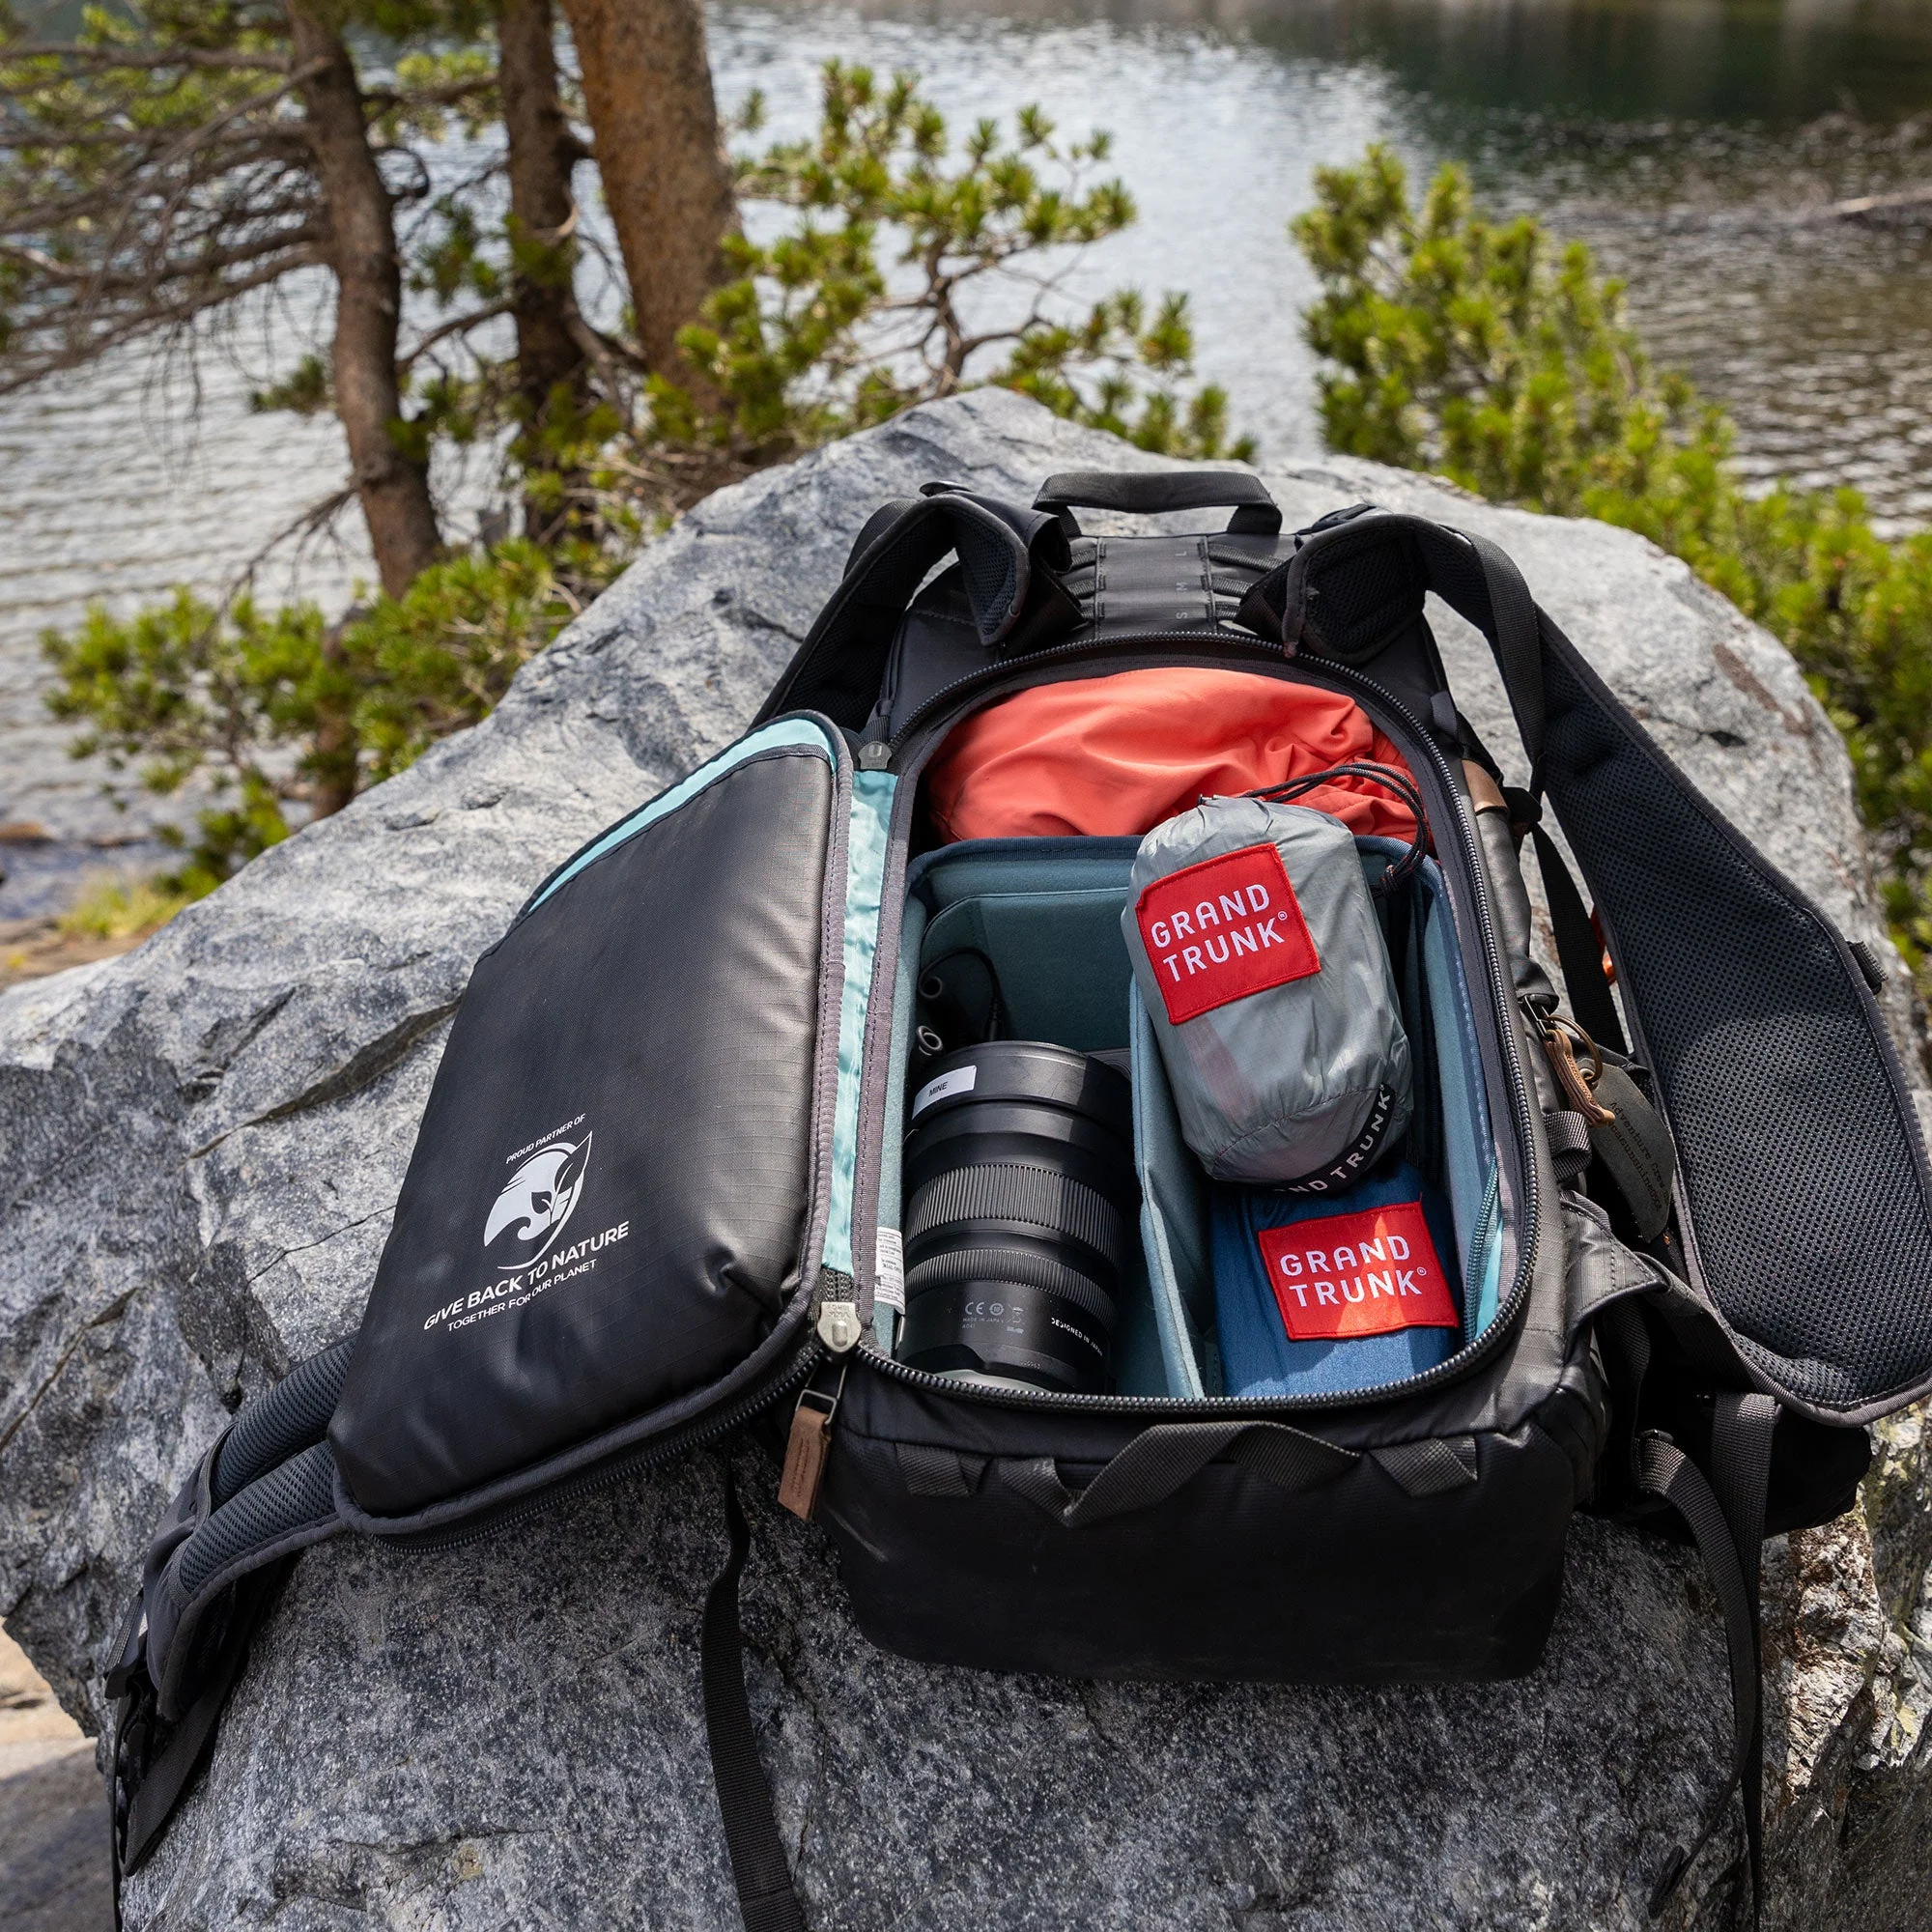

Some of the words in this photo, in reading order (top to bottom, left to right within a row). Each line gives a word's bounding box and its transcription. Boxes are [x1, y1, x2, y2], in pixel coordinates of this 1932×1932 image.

[1151, 883, 1270, 949] GRAND
[928, 1081, 948, 1096] MINE
[505, 1143, 534, 1165] PROUD
[535, 1121, 574, 1149] PARTNER
[574, 1113, 586, 1125] OF
[423, 1297, 465, 1330] GIVE
[467, 1275, 523, 1309] BACK
[527, 1261, 549, 1285] TO
[551, 1220, 630, 1271] NATURE
[1280, 1236, 1410, 1276] GRAND
[447, 1302, 506, 1332] TOGETHER
[508, 1293, 531, 1309] FOR
[531, 1279, 552, 1297] OUR
[554, 1259, 597, 1285] PLANET
[1051, 1317, 1083, 1339] DESIGNED
